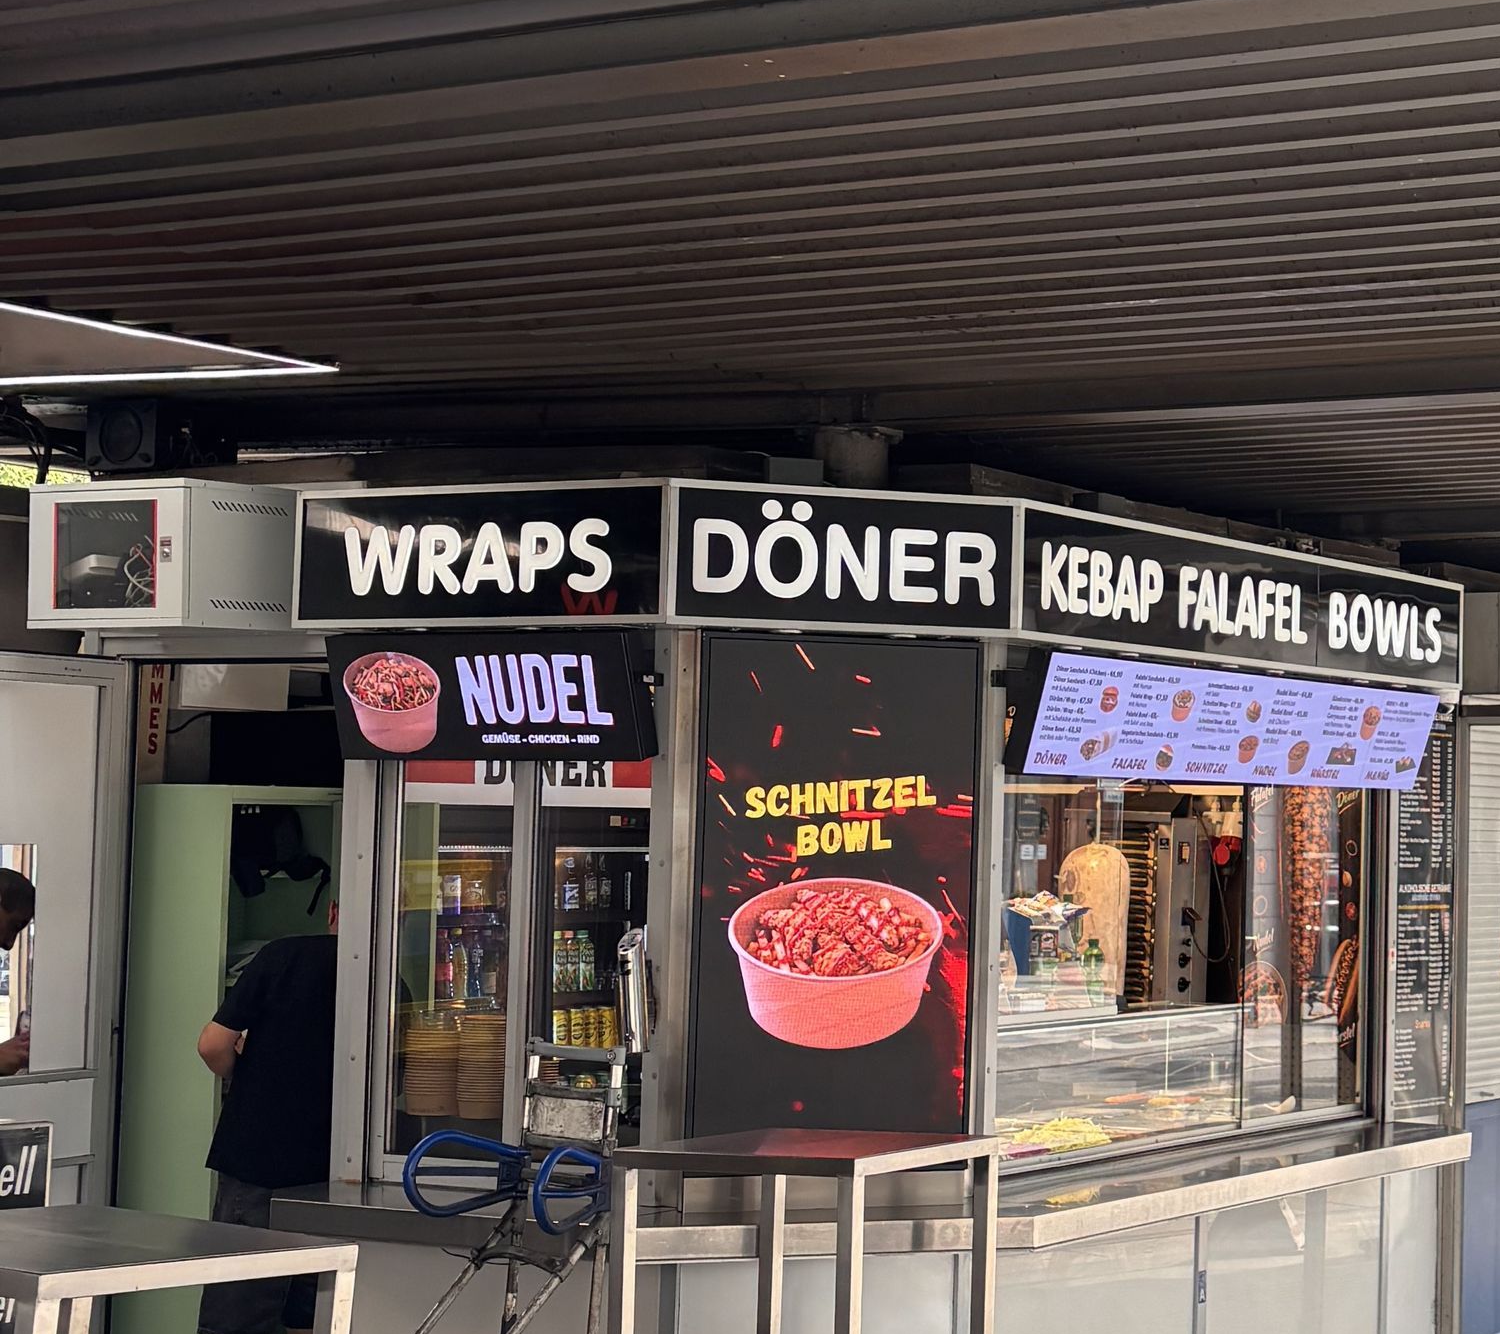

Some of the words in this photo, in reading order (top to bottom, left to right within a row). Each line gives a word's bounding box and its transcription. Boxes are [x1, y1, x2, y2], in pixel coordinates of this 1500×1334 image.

[344, 518, 612, 596] WRAPS
[692, 499, 996, 607] DÖNER
[1040, 540, 1164, 624] KEBAP
[1178, 565, 1308, 645] FALAFEL
[1327, 598, 1443, 663] BOWLS
[455, 653, 614, 726] NUDEL
[482, 732, 522, 744] GEMÜSE
[529, 734, 570, 744] CHICKEN
[577, 734, 601, 744] RIND
[744, 774, 937, 819] SCHNITZEL
[796, 818, 892, 857] BOWL
